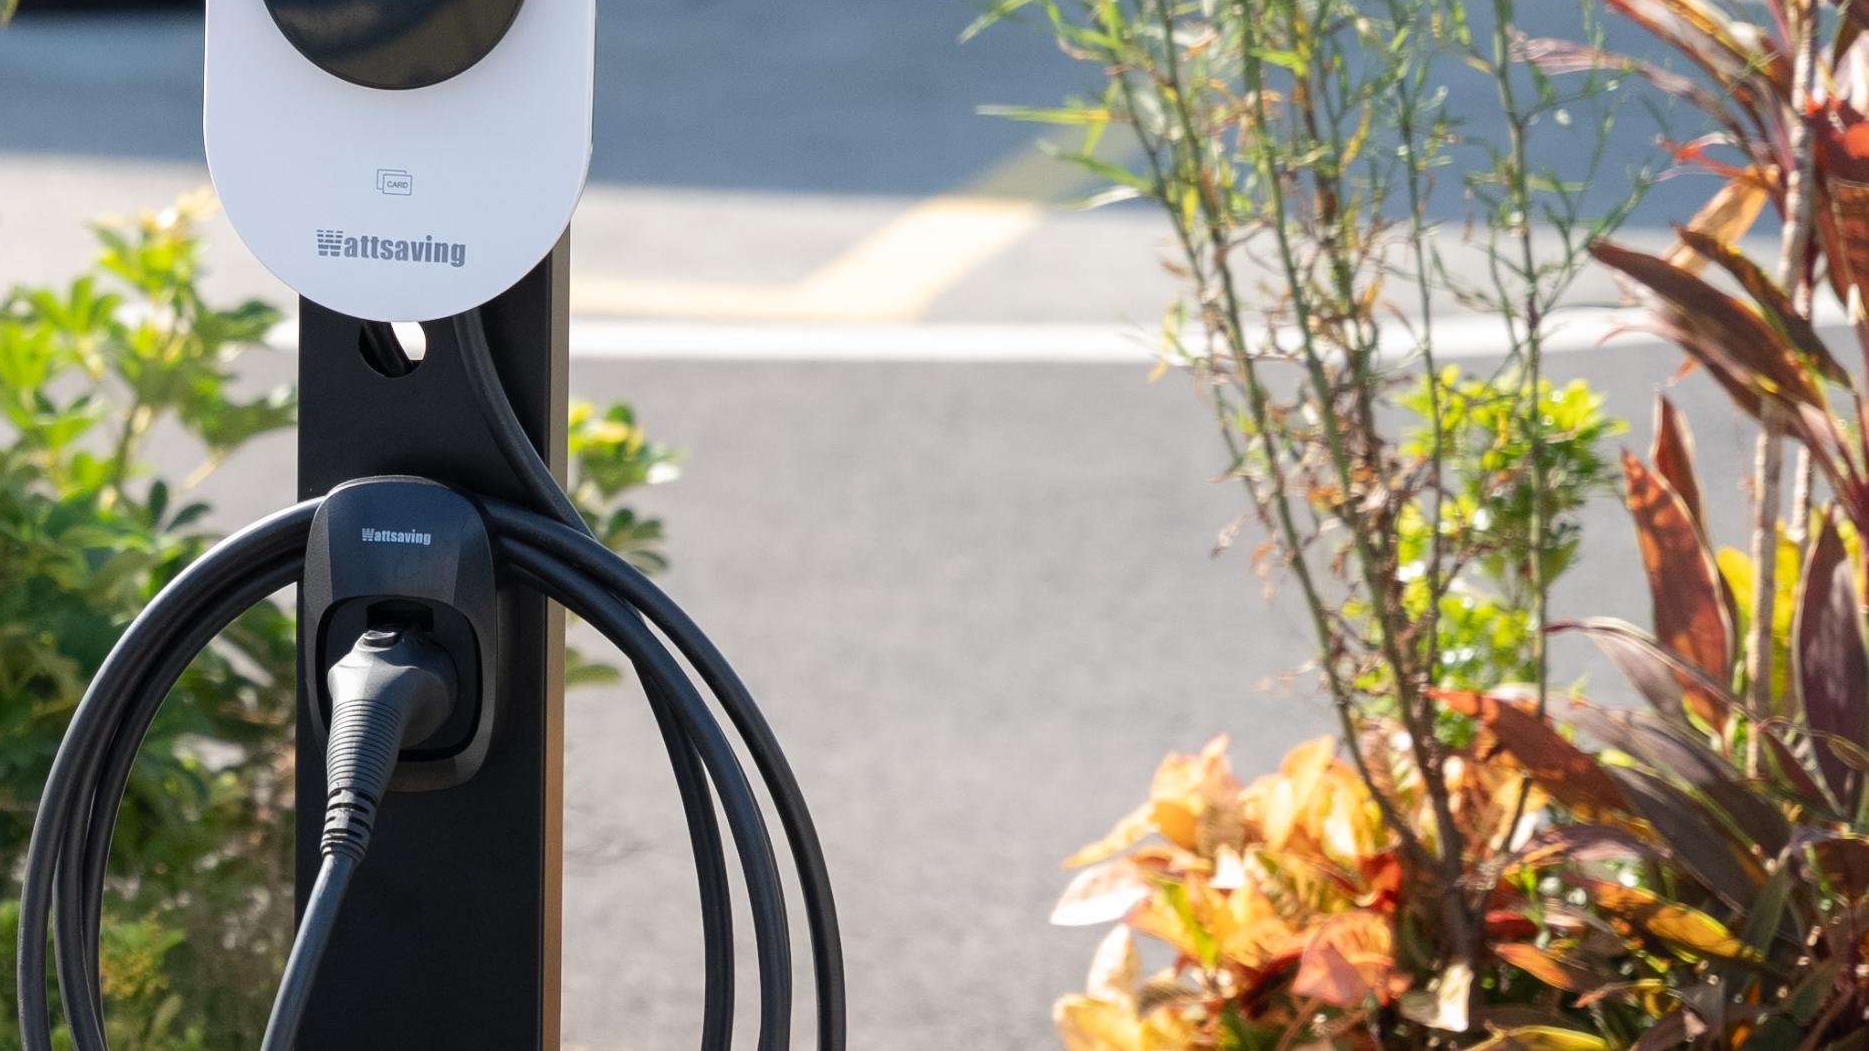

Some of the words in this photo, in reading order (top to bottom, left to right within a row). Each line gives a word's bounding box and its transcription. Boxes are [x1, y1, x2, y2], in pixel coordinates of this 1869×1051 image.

[386, 180, 409, 189] CARD
[316, 229, 467, 268] Wattsaving
[361, 528, 432, 546] Wattsaving
